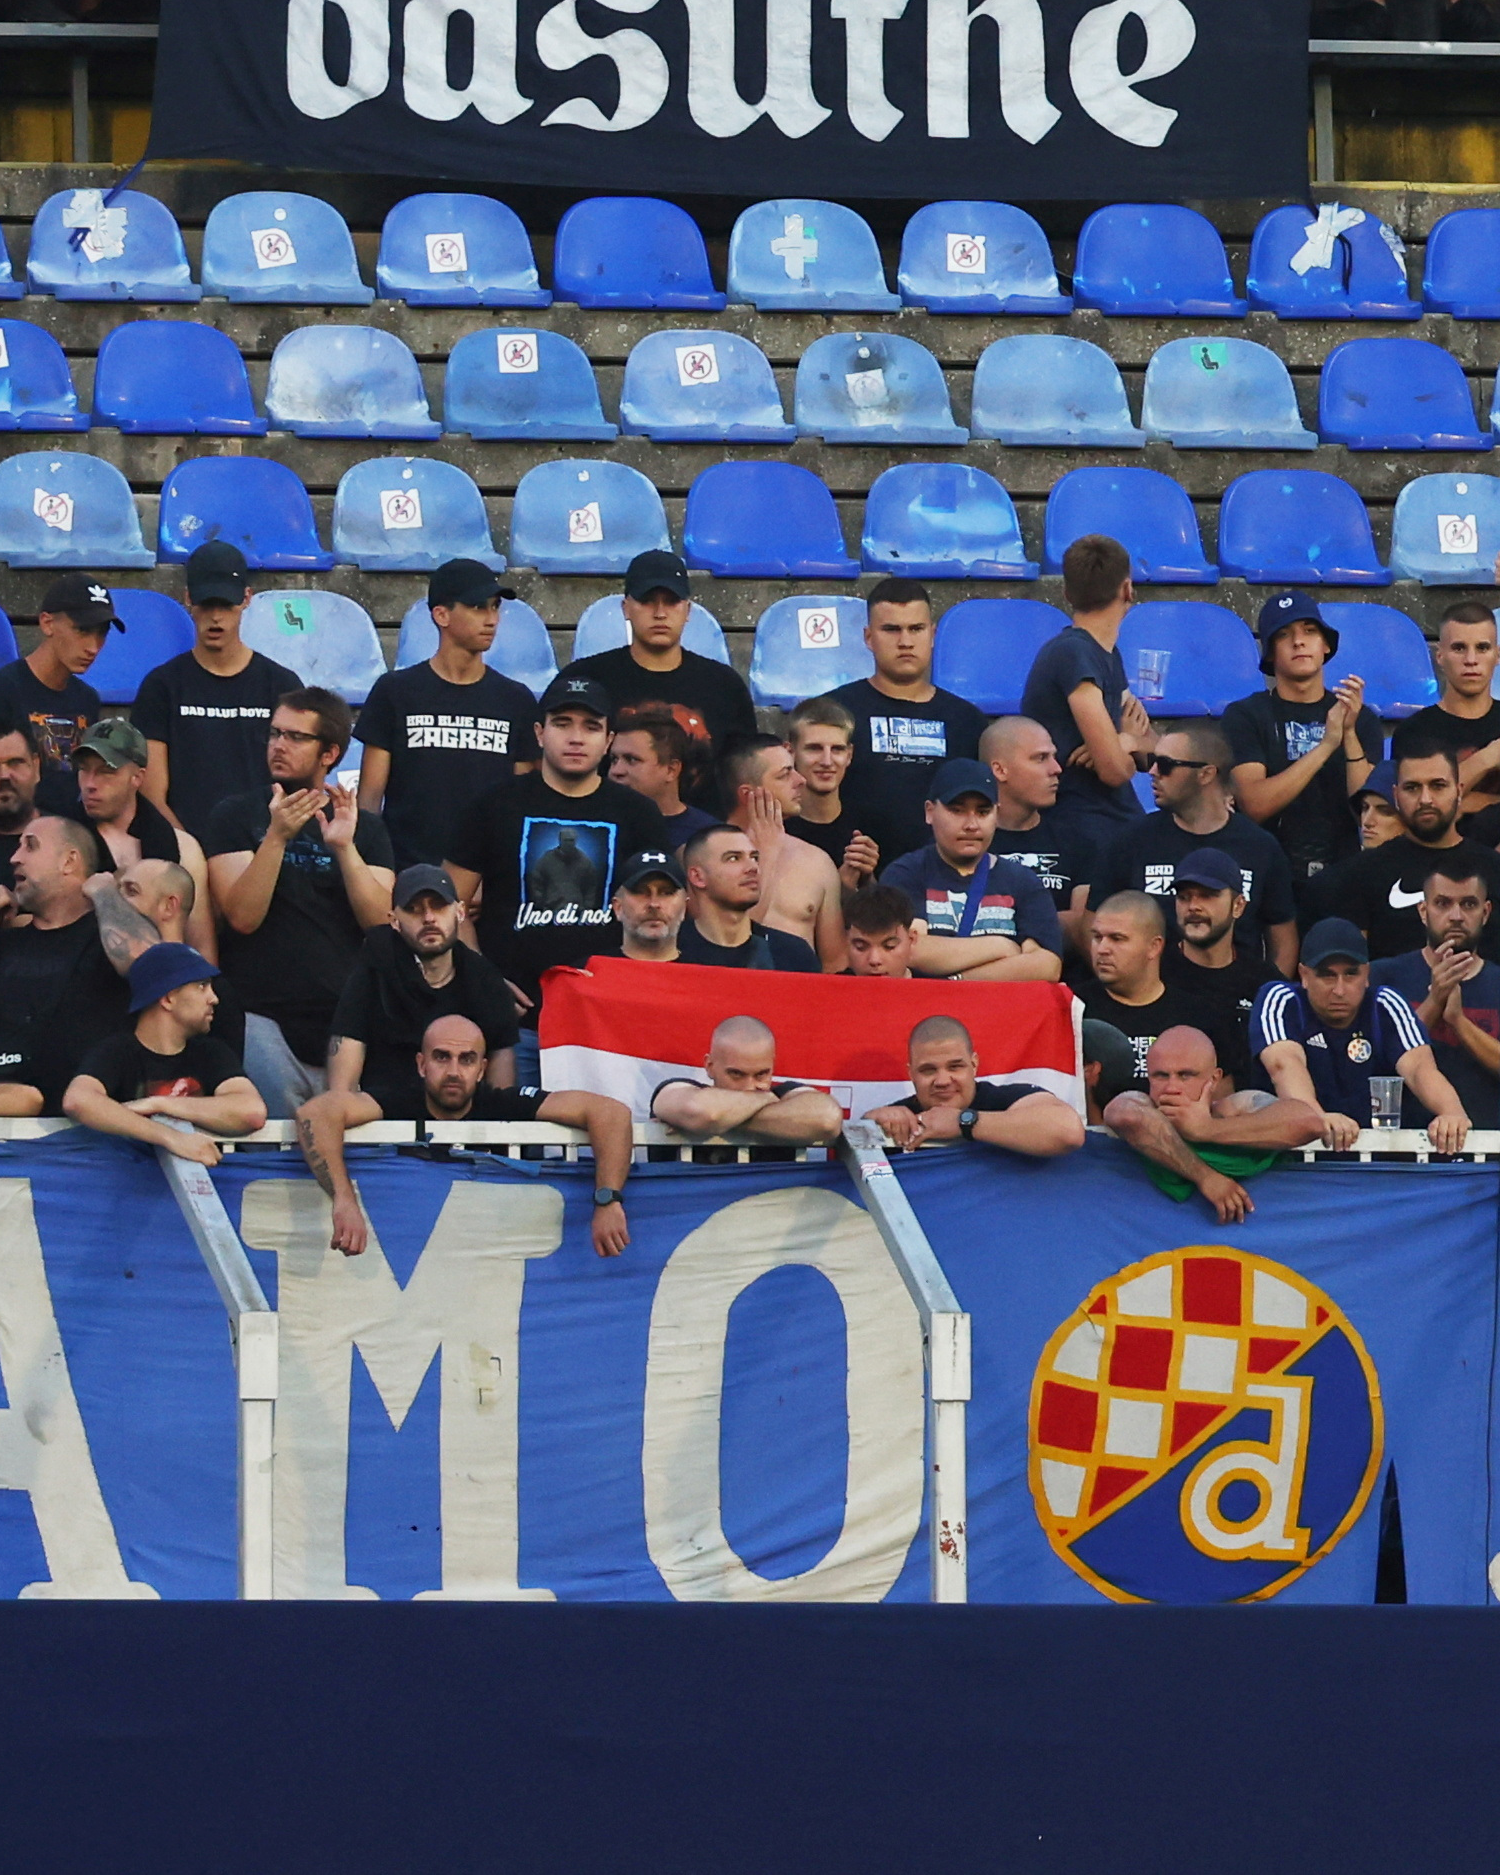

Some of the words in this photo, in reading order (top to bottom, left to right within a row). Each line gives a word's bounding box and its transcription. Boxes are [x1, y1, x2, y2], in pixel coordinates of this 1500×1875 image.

[179, 706, 206, 717] BAD
[206, 707, 238, 720] BLUE
[239, 706, 271, 718] BOYS
[405, 715, 434, 728] BAD
[436, 715, 474, 729] BLUE
[476, 717, 510, 733] BOYS
[406, 727, 508, 755] ZAGREB
[1144, 864, 1174, 876] BAD
[514, 902, 555, 931] Uno
[555, 901, 578, 925] di
[579, 902, 614, 925] noi
